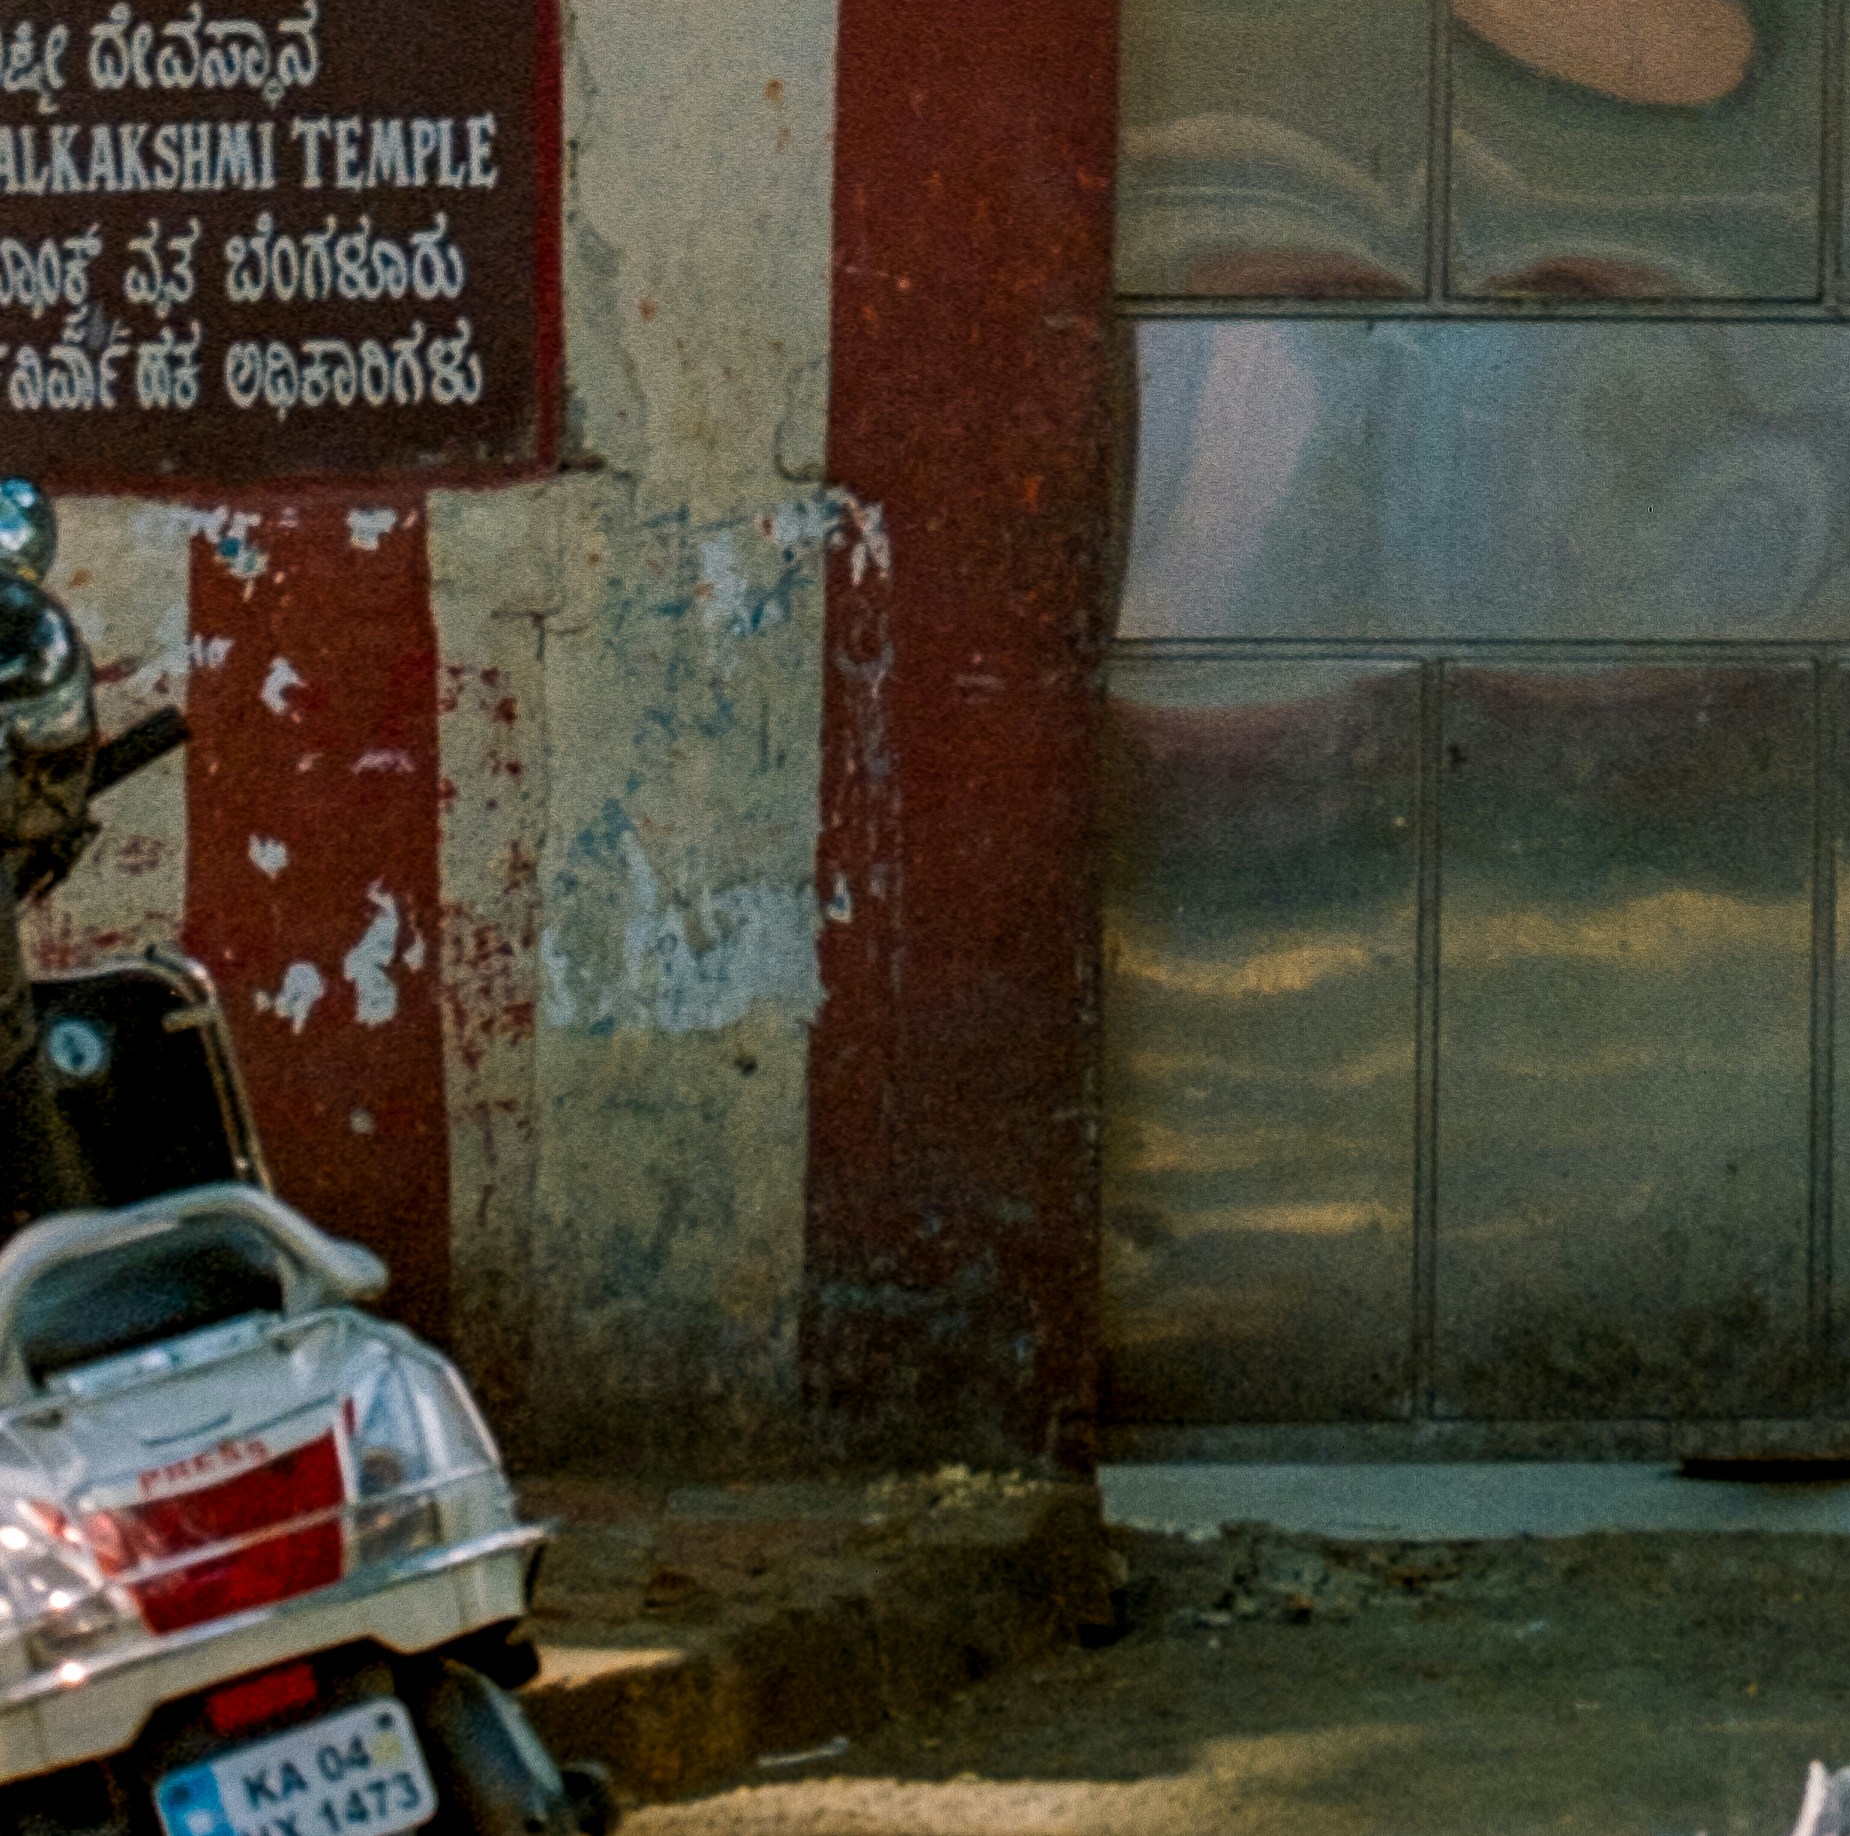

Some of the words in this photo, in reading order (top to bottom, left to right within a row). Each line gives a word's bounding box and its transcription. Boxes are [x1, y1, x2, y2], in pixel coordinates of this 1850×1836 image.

[87, 0, 320, 108] ದೇವಸ್ಥಾನ
[289, 113, 498, 190] TEMPLE
[223, 211, 466, 303] ಬೆಂಗಳೂರು
[241, 1760, 308, 1812] KA
[322, 1771, 421, 1834] 1473
